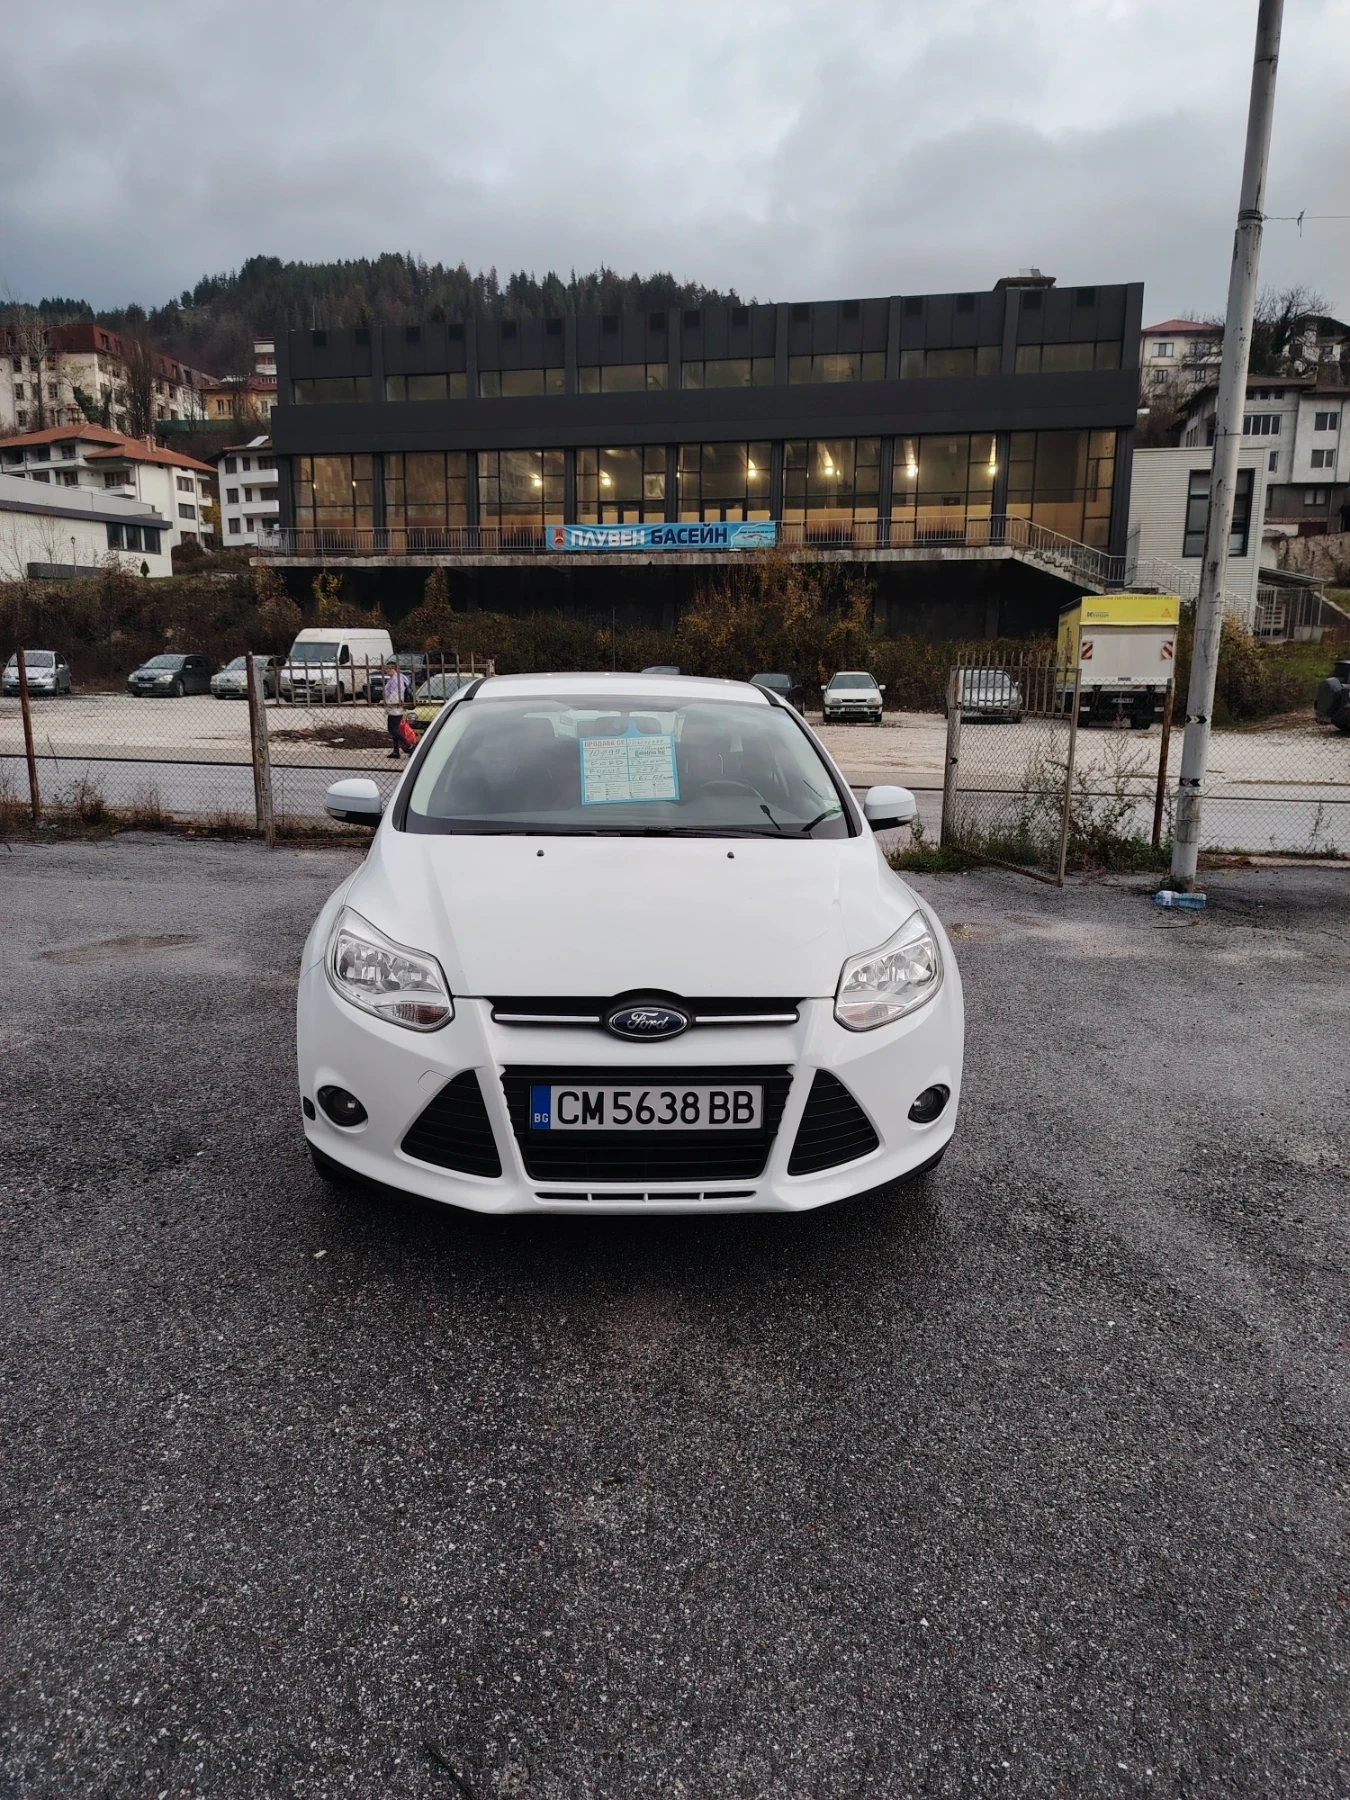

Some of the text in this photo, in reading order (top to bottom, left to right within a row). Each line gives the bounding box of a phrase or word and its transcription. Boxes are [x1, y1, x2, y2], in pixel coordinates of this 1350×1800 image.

[571, 523, 728, 547] ПЛУВЕН БАСЕЙН
[627, 1011, 669, 1030] Ford
[534, 1090, 755, 1125] BG CM 5638 BB
